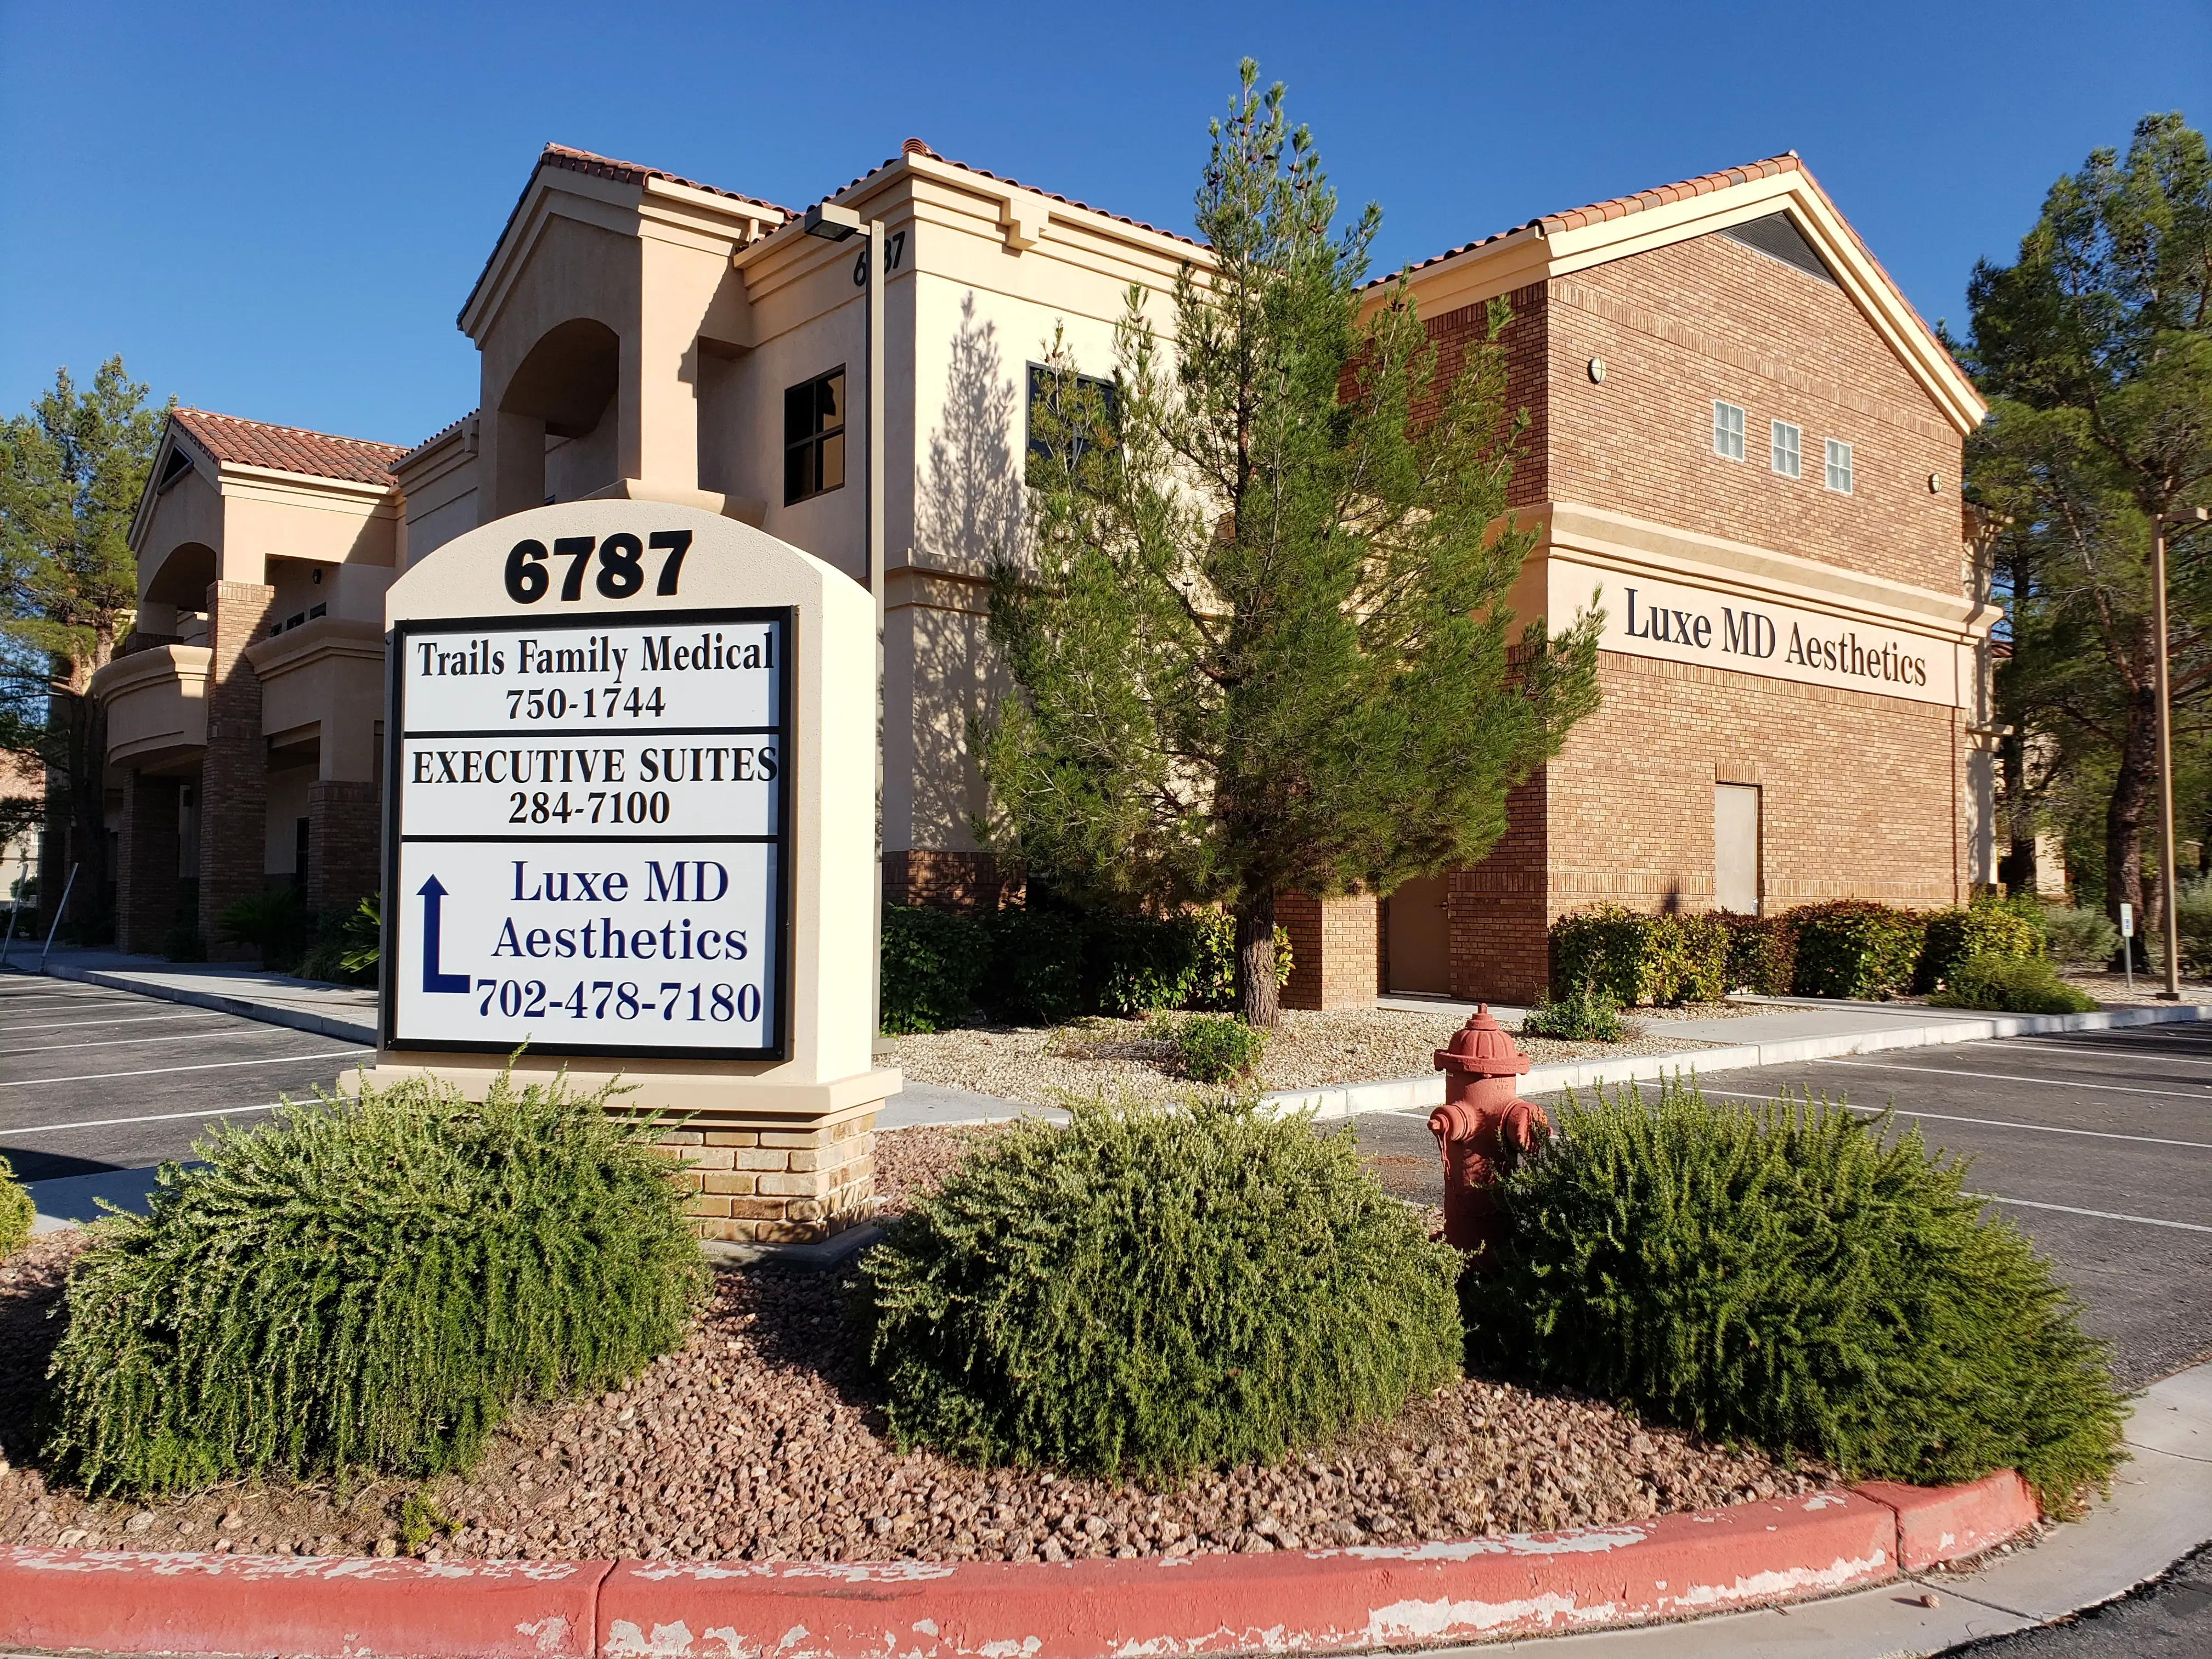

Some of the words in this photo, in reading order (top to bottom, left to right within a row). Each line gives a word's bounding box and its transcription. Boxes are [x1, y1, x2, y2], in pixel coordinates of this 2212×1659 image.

[505, 530, 692, 604] 6787
[417, 640, 505, 677] Trails
[518, 635, 629, 684] Family
[641, 631, 775, 673] Medical
[1624, 587, 1712, 648] Luxe
[1720, 606, 1776, 659] MD
[1785, 621, 1927, 687] Aesthetics
[506, 686, 666, 720] 750-1744
[411, 749, 625, 783] EXECUTIVE
[640, 746, 778, 782] SUITES
[509, 791, 670, 824] 284-7100
[510, 861, 629, 902] Luxe
[644, 861, 729, 902] MD
[490, 917, 748, 960] Aesthetics
[477, 979, 761, 1023] 702-478-7180
